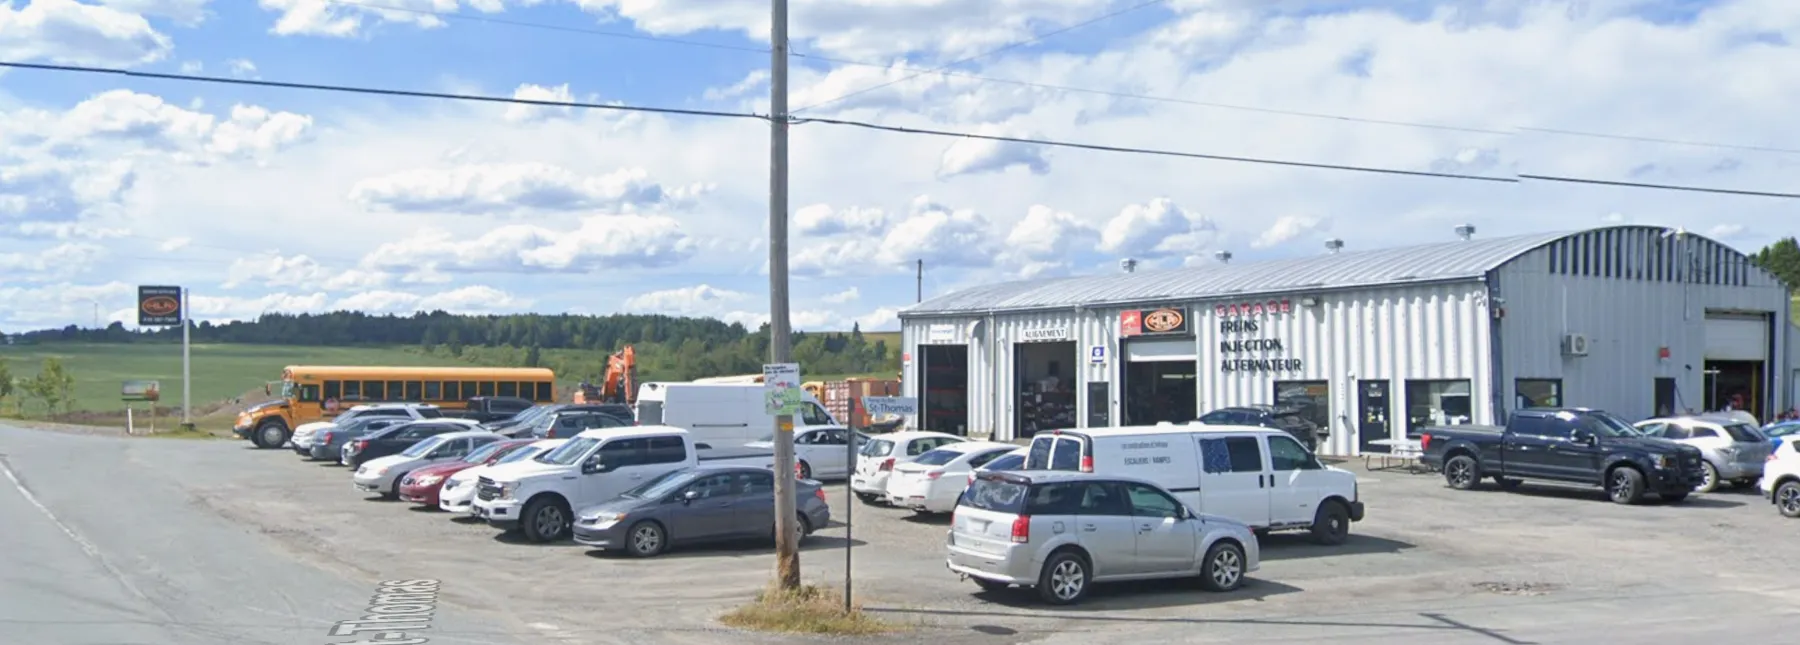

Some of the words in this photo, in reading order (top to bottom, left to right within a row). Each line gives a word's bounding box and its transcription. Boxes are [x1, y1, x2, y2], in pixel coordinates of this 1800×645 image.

[1215, 300, 1290, 318] GARAGE
[1220, 319, 1258, 333] FREINS
[1024, 329, 1066, 339] ALIGNEMENT
[1220, 338, 1282, 353] INJECTION
[1221, 358, 1302, 373] ALTERNATEUR
[869, 403, 913, 413] St-Thomas
